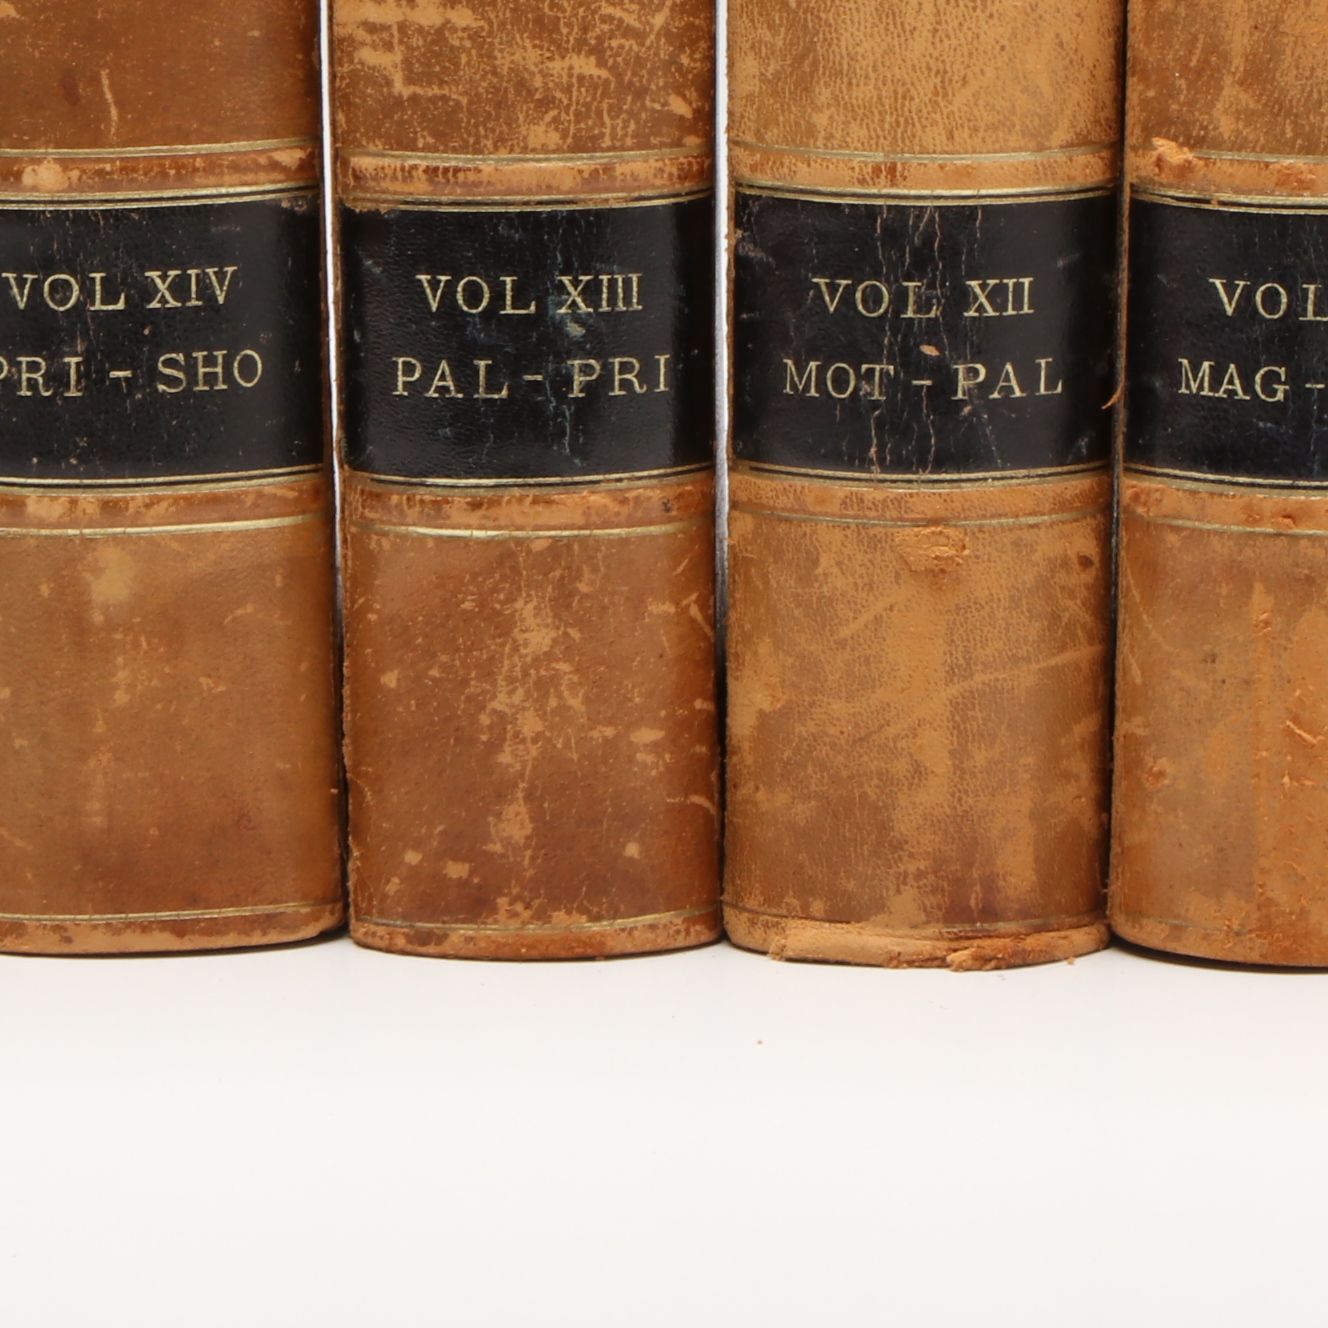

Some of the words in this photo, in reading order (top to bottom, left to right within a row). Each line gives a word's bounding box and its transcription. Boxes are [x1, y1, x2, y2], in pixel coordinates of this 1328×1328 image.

[2, 273, 125, 311] VOL
[145, 266, 238, 309] XIV
[416, 275, 536, 315] VOL
[556, 273, 643, 314] XIII
[812, 278, 938, 318] VOL
[963, 277, 1034, 317] XII
